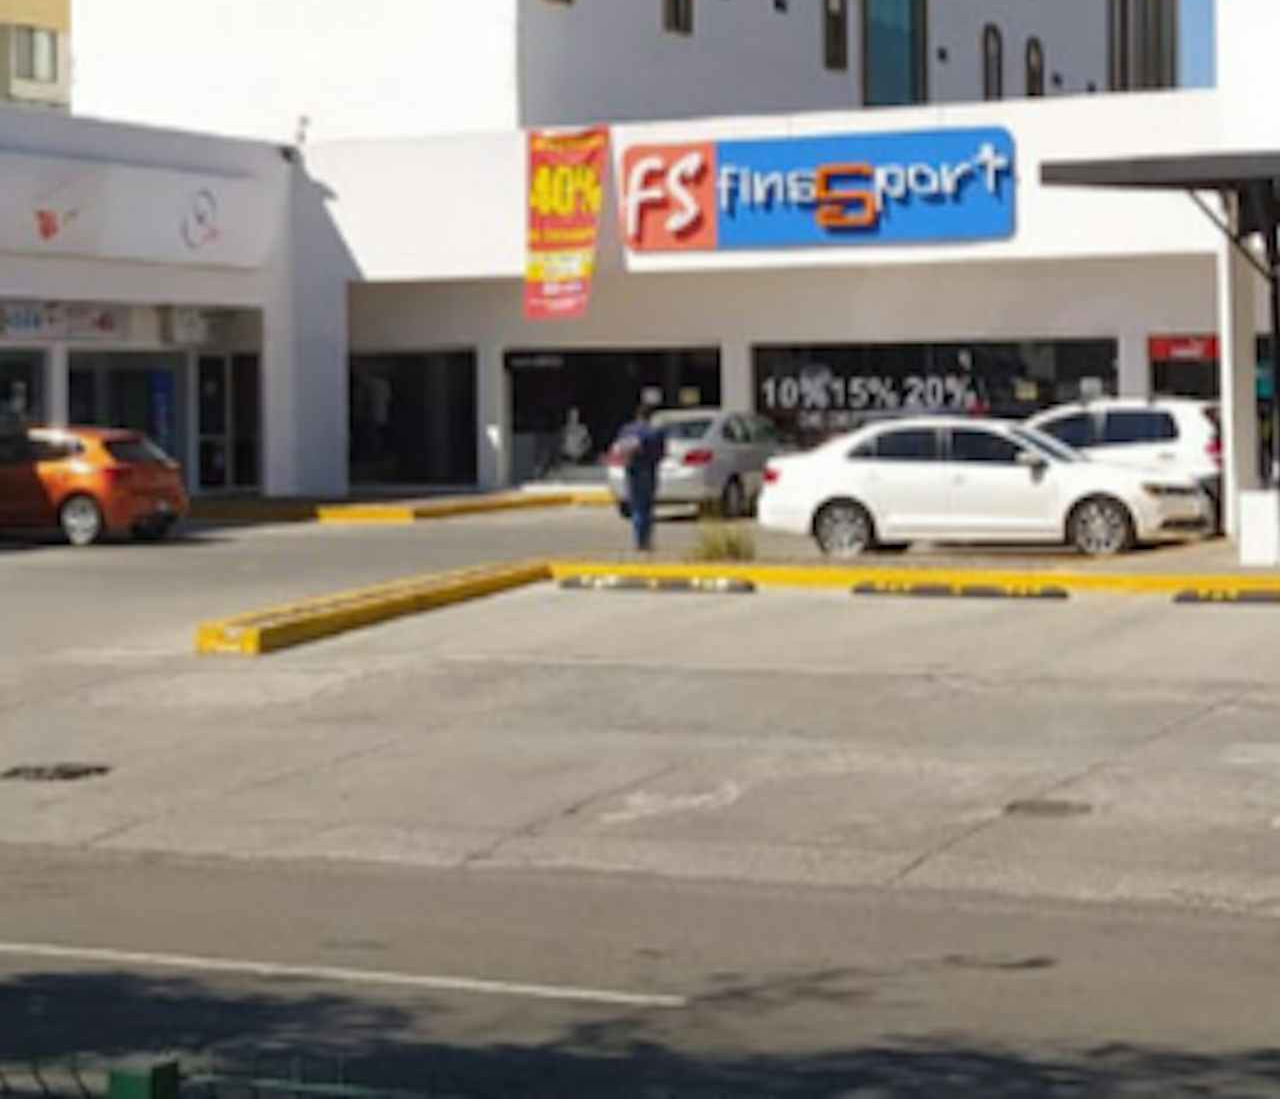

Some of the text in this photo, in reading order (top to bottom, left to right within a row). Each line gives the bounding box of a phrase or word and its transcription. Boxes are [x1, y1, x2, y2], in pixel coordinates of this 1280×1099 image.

[530, 164, 603, 216] 40%
[626, 150, 704, 236] FS
[761, 375, 830, 409] 10%
[831, 375, 899, 408] 15%
